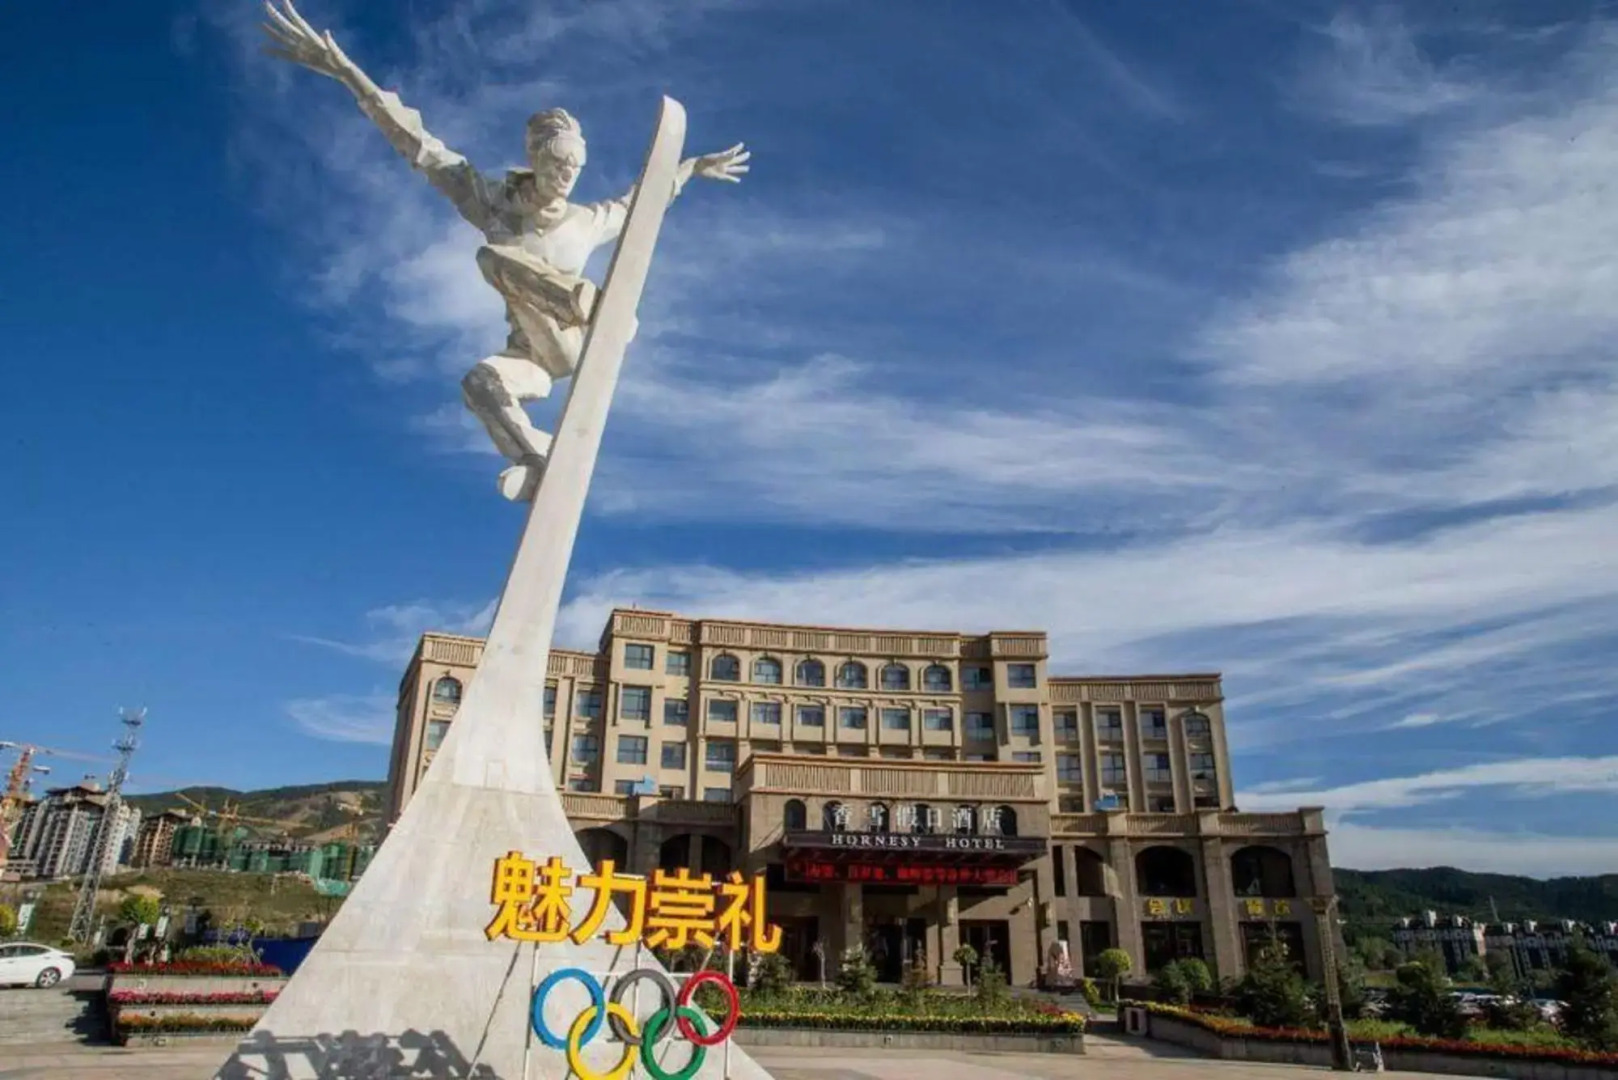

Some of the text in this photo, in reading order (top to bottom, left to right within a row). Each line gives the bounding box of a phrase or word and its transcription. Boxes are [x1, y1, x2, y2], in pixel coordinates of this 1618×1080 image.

[832, 834, 1005, 850] HORNESY HOTEL
[484, 850, 783, 954] 魅力崇礼
